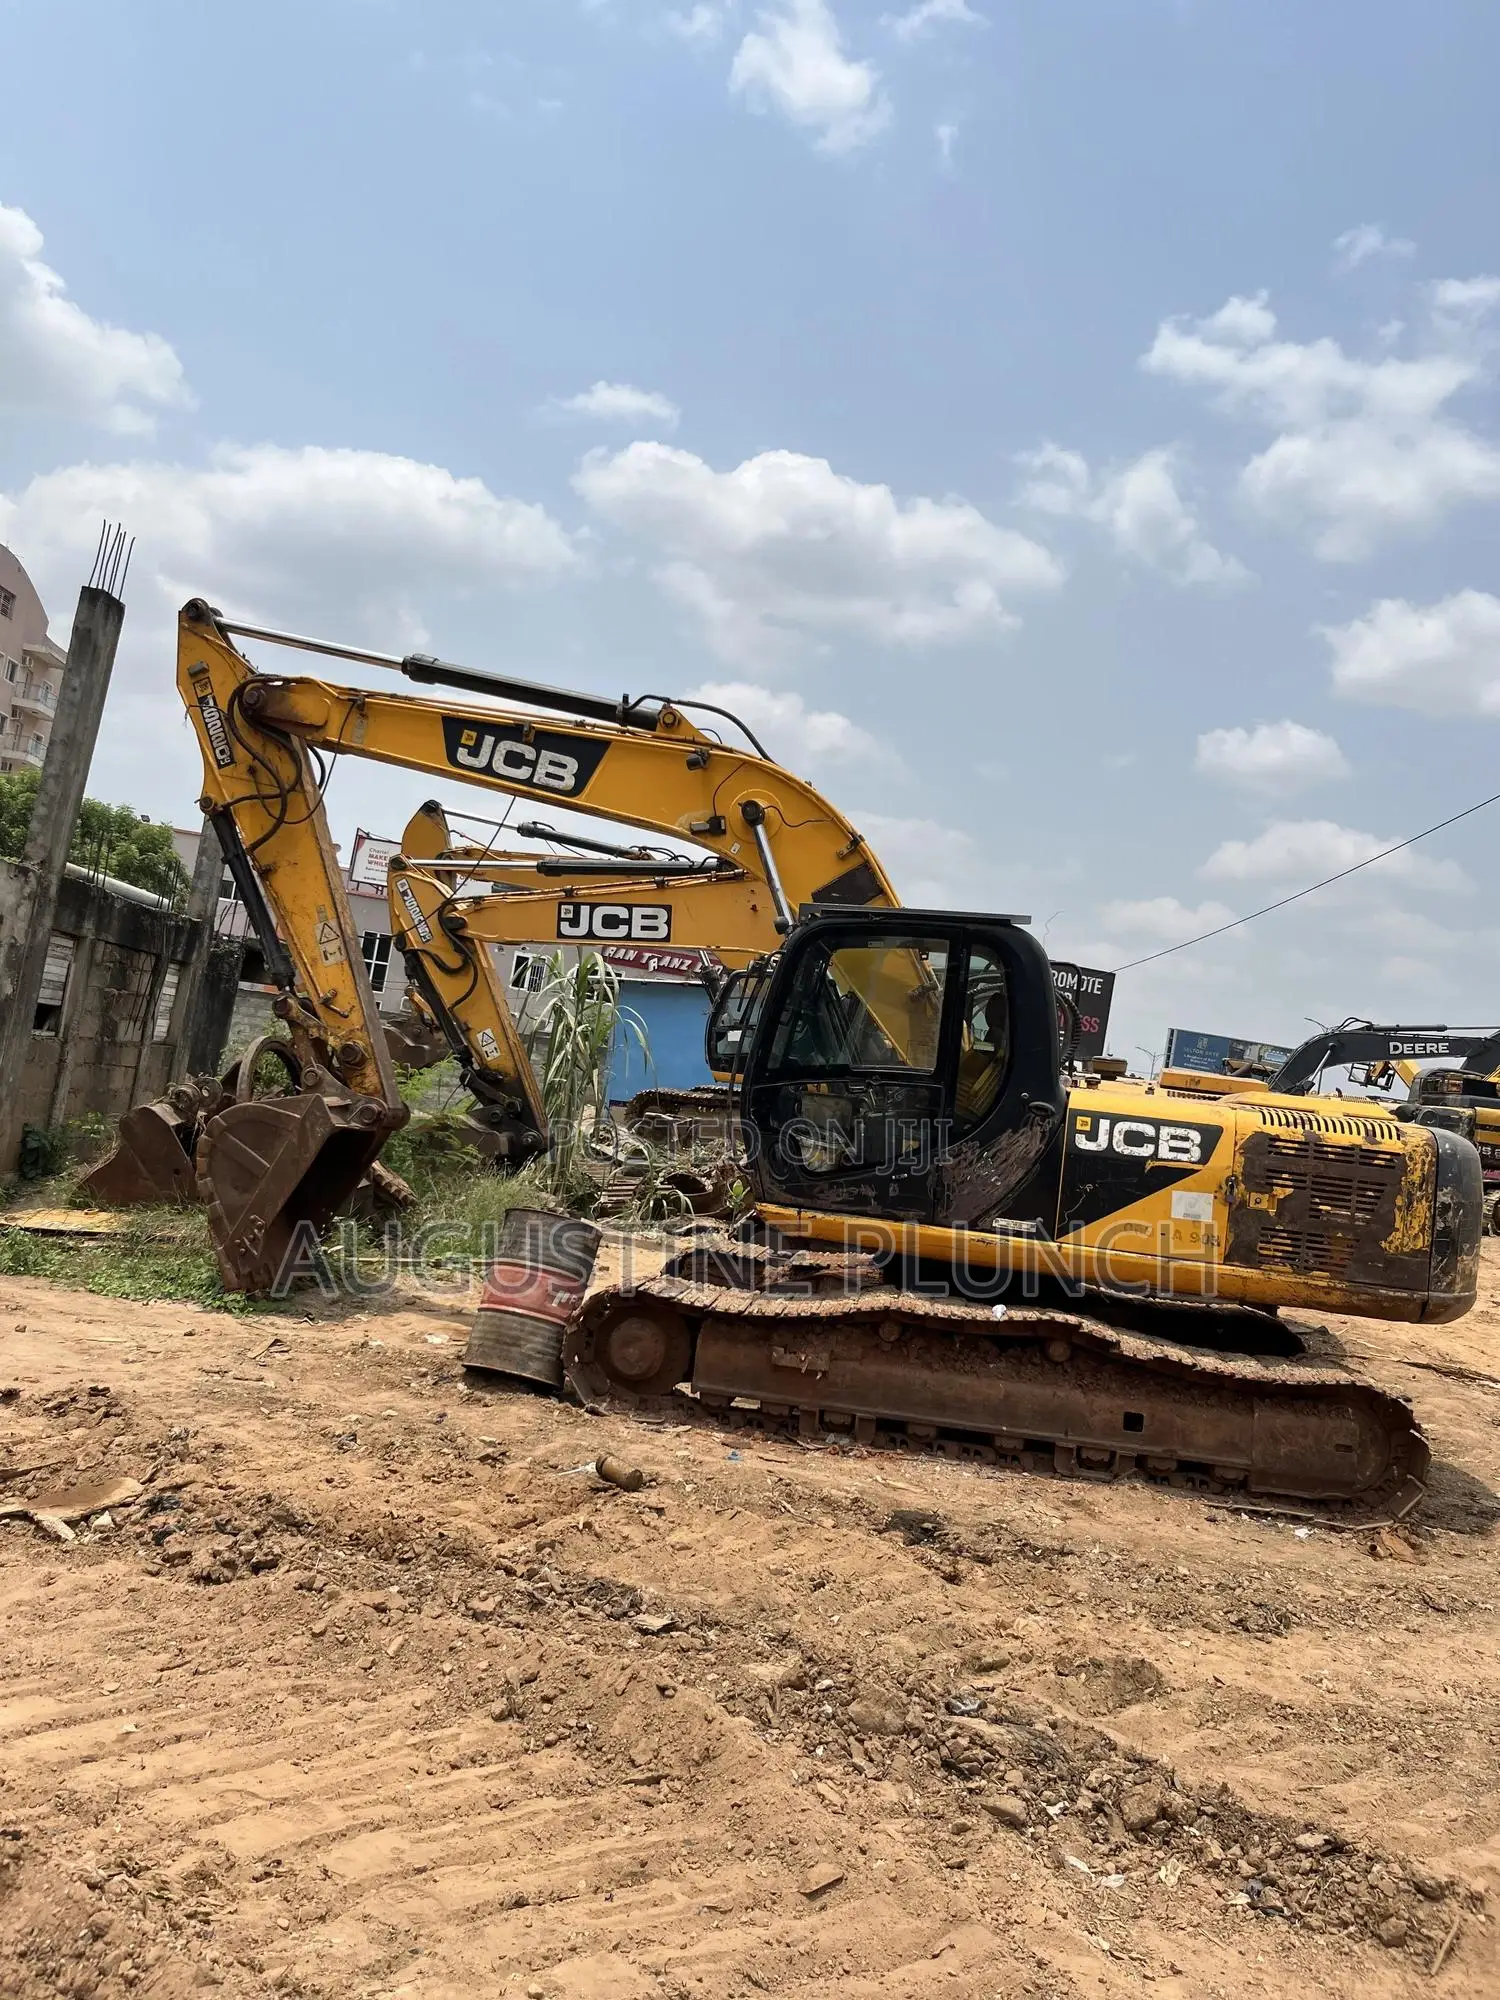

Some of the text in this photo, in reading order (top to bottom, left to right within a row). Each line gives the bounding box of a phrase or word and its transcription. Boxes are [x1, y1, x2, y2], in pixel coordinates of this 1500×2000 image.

[456, 734, 579, 791] JCB
[368, 853, 388, 861] MAKE
[560, 904, 669, 939] JCB
[1051, 969, 1104, 995] ROMOTE
[1389, 1041, 1450, 1055] DEERE
[1075, 1118, 1202, 1162] JCB
